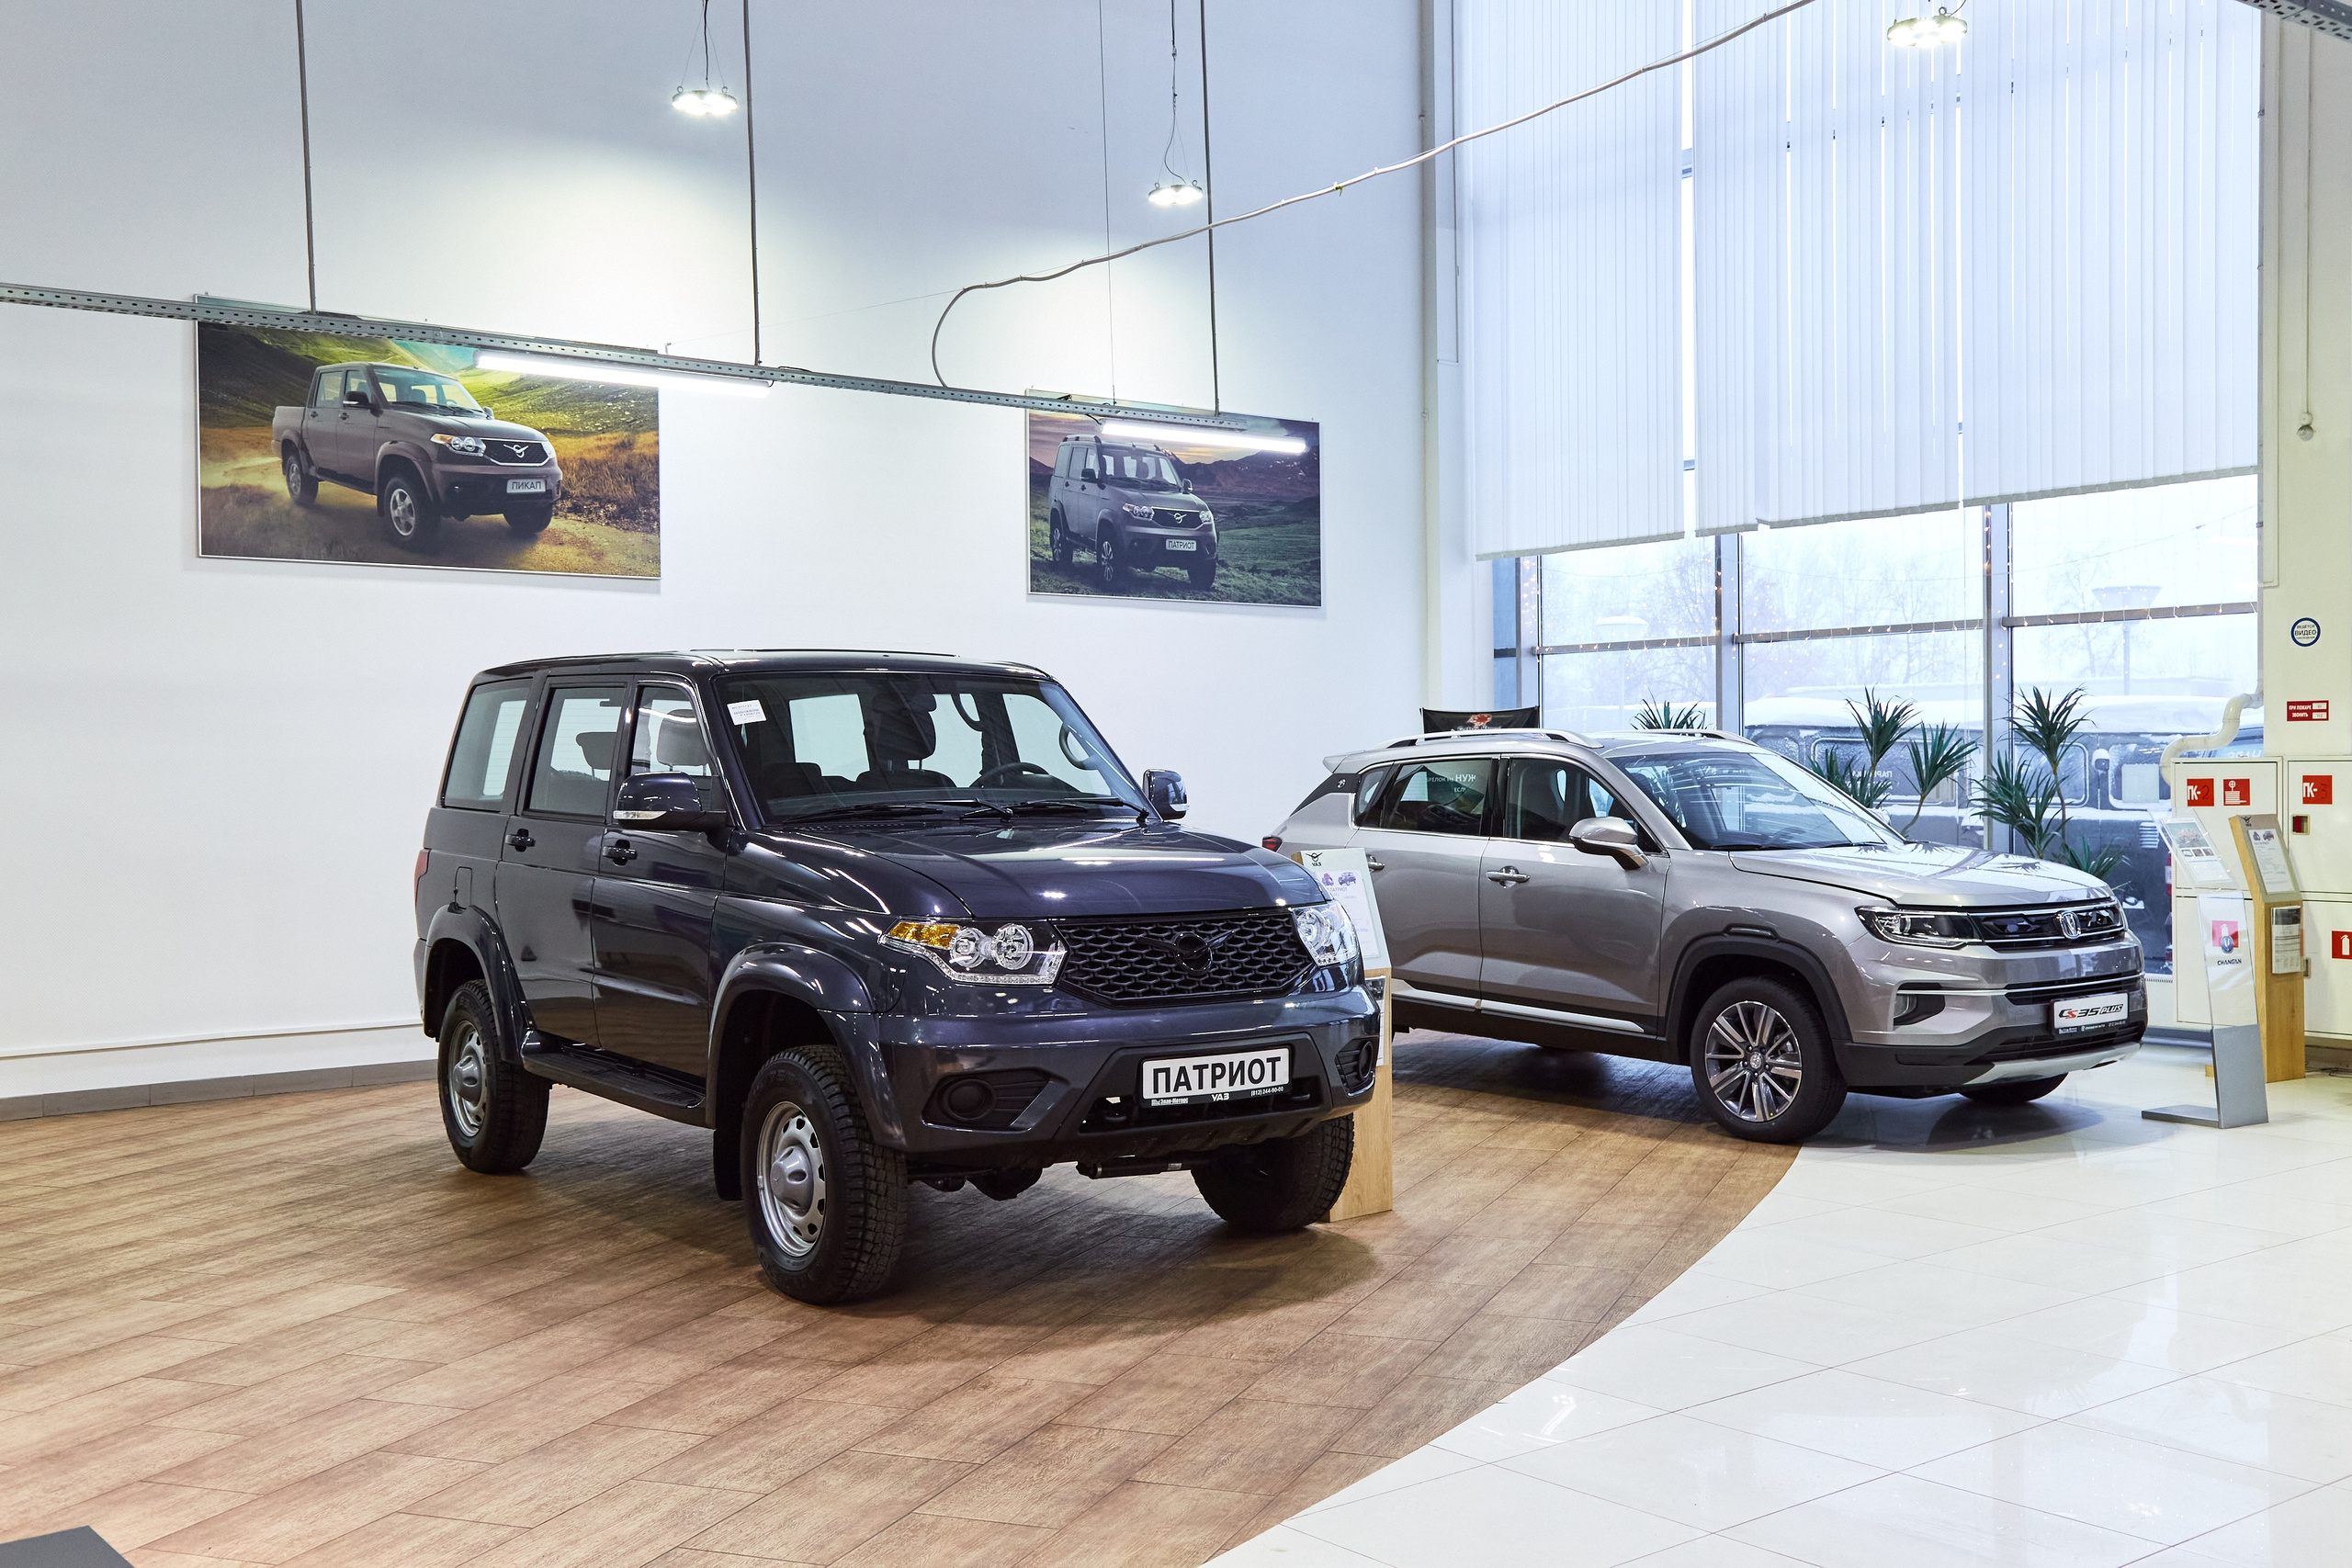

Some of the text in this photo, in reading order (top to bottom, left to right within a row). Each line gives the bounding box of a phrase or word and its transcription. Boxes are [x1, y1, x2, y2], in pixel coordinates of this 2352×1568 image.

[512, 481, 542, 491] ПИКАП
[1169, 540, 1195, 549] ПАТРИОТ
[1153, 1056, 1281, 1094] ПАТРИОТ
[1211, 1093, 1229, 1101] УАЗ
